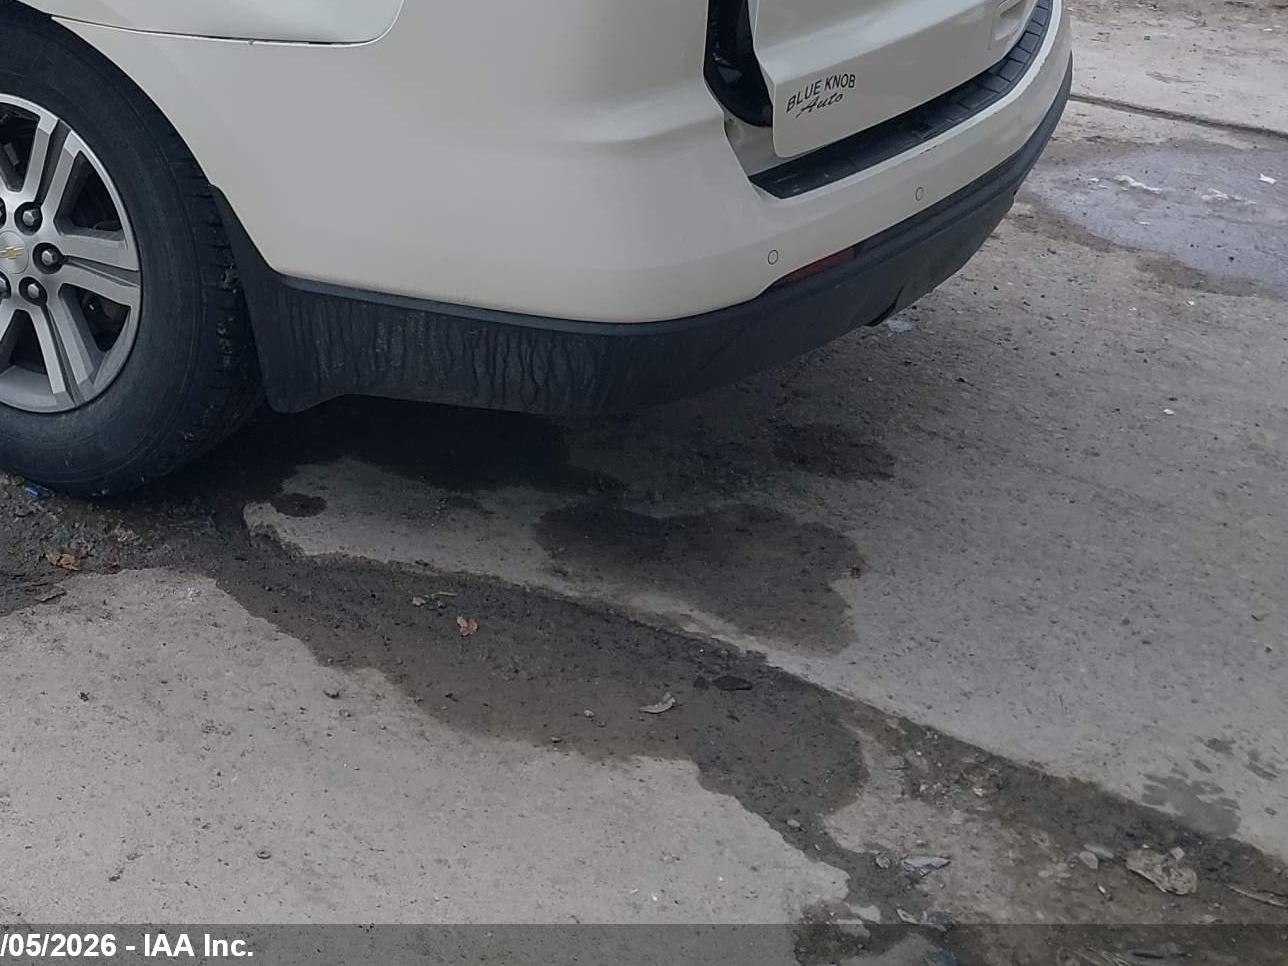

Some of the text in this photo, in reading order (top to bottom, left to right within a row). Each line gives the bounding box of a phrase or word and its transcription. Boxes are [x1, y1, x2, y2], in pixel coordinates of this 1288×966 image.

[786, 74, 856, 113] BLUE KNOB
[795, 92, 843, 118] Auto
